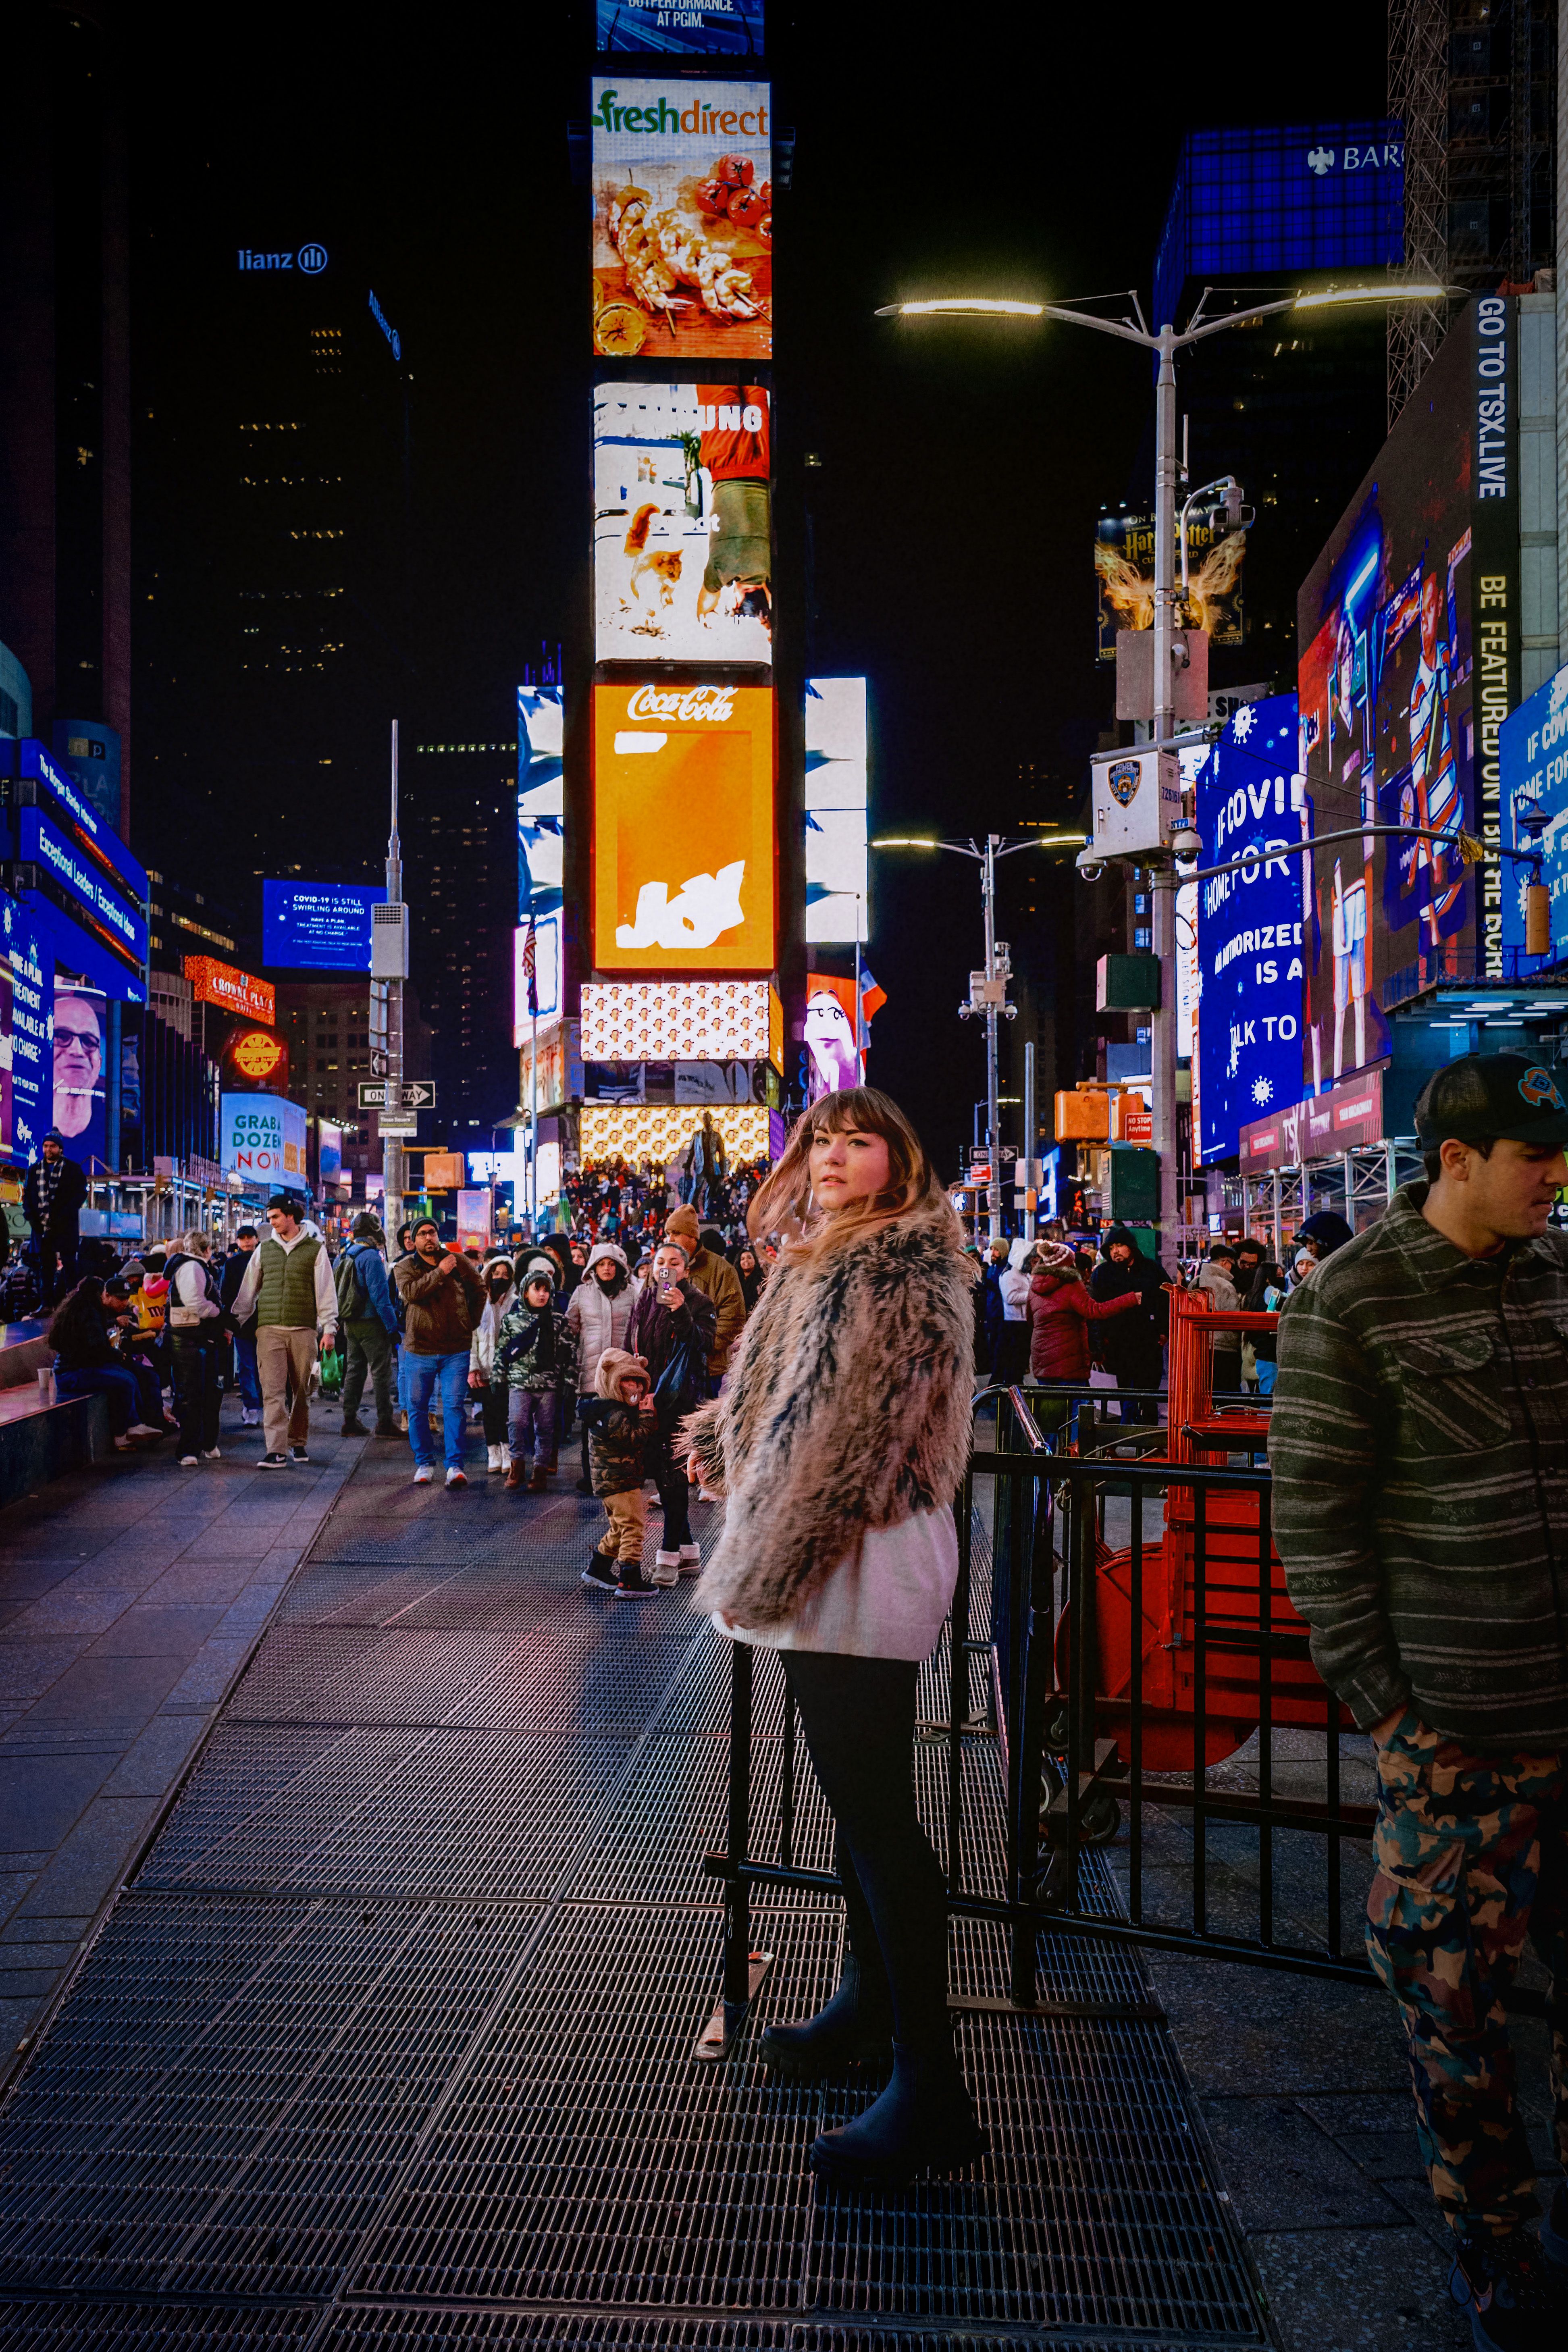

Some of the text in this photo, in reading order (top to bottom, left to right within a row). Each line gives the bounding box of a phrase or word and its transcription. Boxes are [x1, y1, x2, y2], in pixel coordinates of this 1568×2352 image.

[657, 11, 704, 28] AT PGIM.
[598, 89, 769, 136] freshdirect
[1343, 145, 1404, 170] BAR
[1478, 297, 1506, 499] GO TO TSX.LIVE
[1174, 523, 1215, 547] Ptter
[1480, 576, 1507, 609] BE
[1481, 622, 1507, 756] FEATURED
[1527, 705, 1568, 763] IF COV
[1171, 818, 1189, 829] NYPD
[1217, 806, 1226, 848] IF
[1206, 839, 1291, 919] HOME FOR
[293, 904, 364, 915] SWIRLING AROUND
[294, 894, 329, 904] COVID-19
[1256, 960, 1278, 985] IS
[1262, 1015, 1297, 1042] TO
[370, 1091, 423, 1100] ON WAY
[235, 1115, 276, 1130] GRAB
[1128, 1125, 1150, 1133] Anytime
[233, 1132, 281, 1148] DOZEN
[237, 1151, 281, 1170] NOW
